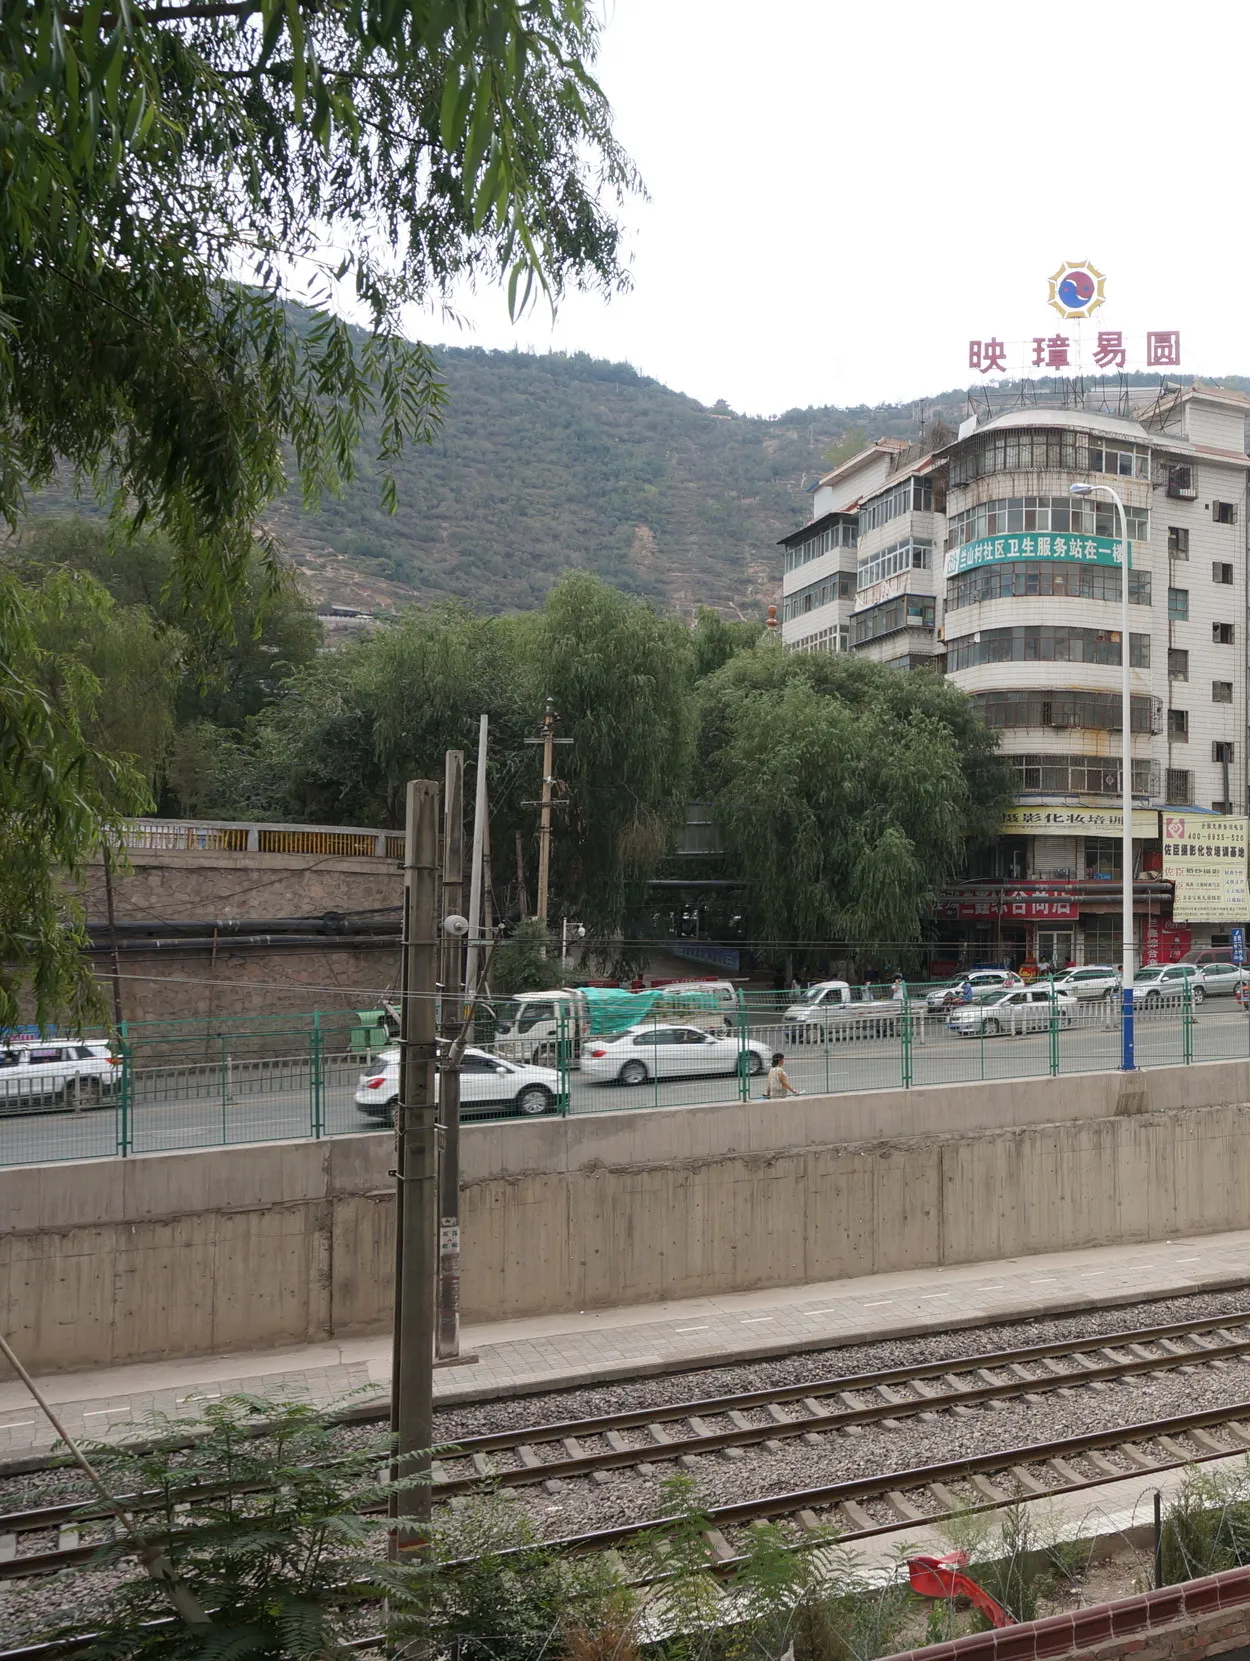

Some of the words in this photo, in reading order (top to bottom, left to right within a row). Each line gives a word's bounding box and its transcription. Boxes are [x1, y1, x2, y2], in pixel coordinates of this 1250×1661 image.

[968, 331, 1181, 374] 映璋易圆
[959, 536, 1124, 567] 兰山村社区卫生服务站在一楼
[1164, 843, 1245, 858] 佐臣摄影化妆培训基地
